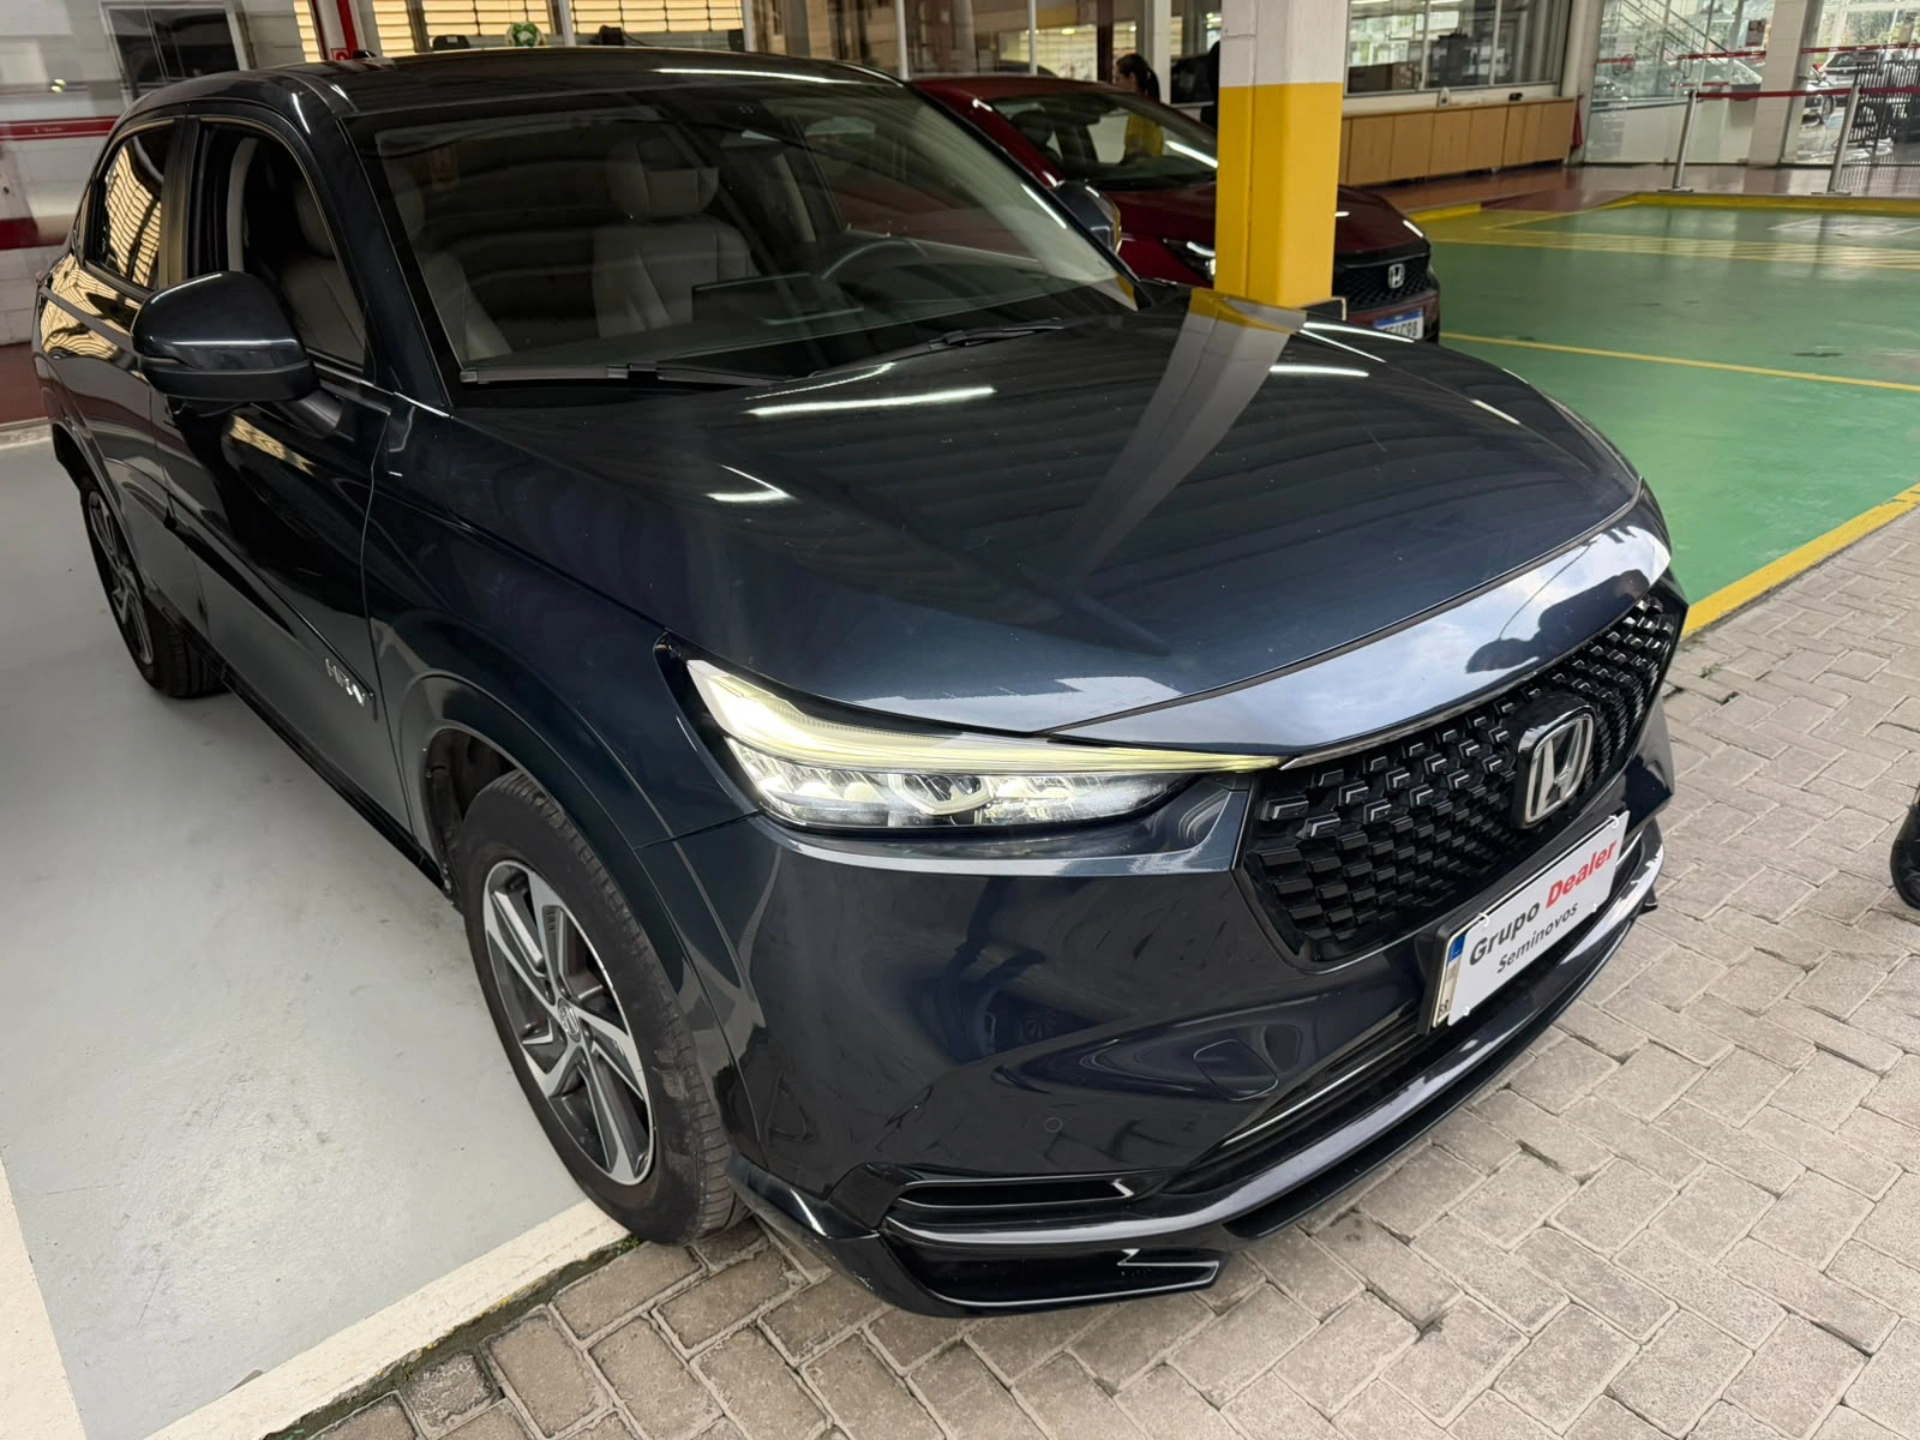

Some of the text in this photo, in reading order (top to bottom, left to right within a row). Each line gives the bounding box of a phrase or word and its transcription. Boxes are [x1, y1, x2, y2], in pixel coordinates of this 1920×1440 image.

[1469, 841, 1617, 966] Grupo Dealer
[1497, 902, 1579, 974] Seminovos
